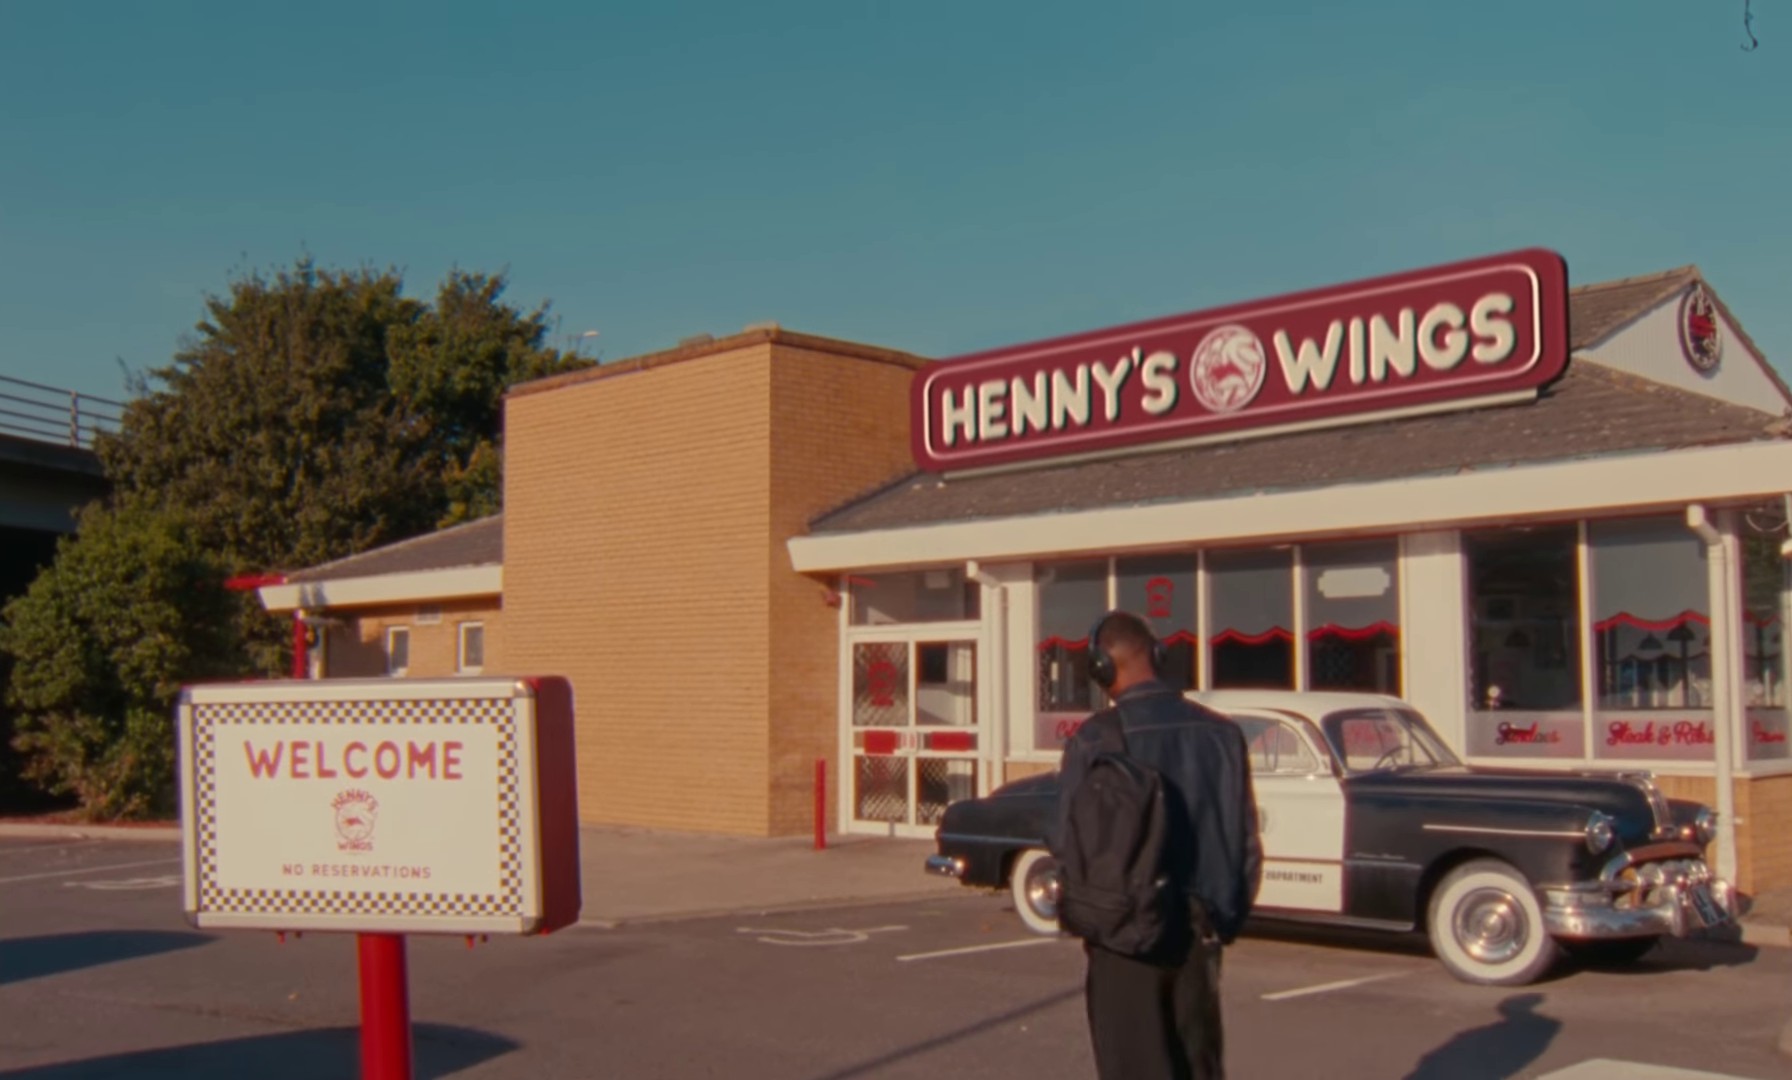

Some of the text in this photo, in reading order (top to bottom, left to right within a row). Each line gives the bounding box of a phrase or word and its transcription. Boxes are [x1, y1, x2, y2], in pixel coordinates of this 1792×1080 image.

[942, 292, 1515, 447] HENNY'S WINGS
[243, 740, 463, 780] WELCOME
[338, 841, 374, 851] WINGS
[282, 863, 431, 879] NO RESERVATIONS
